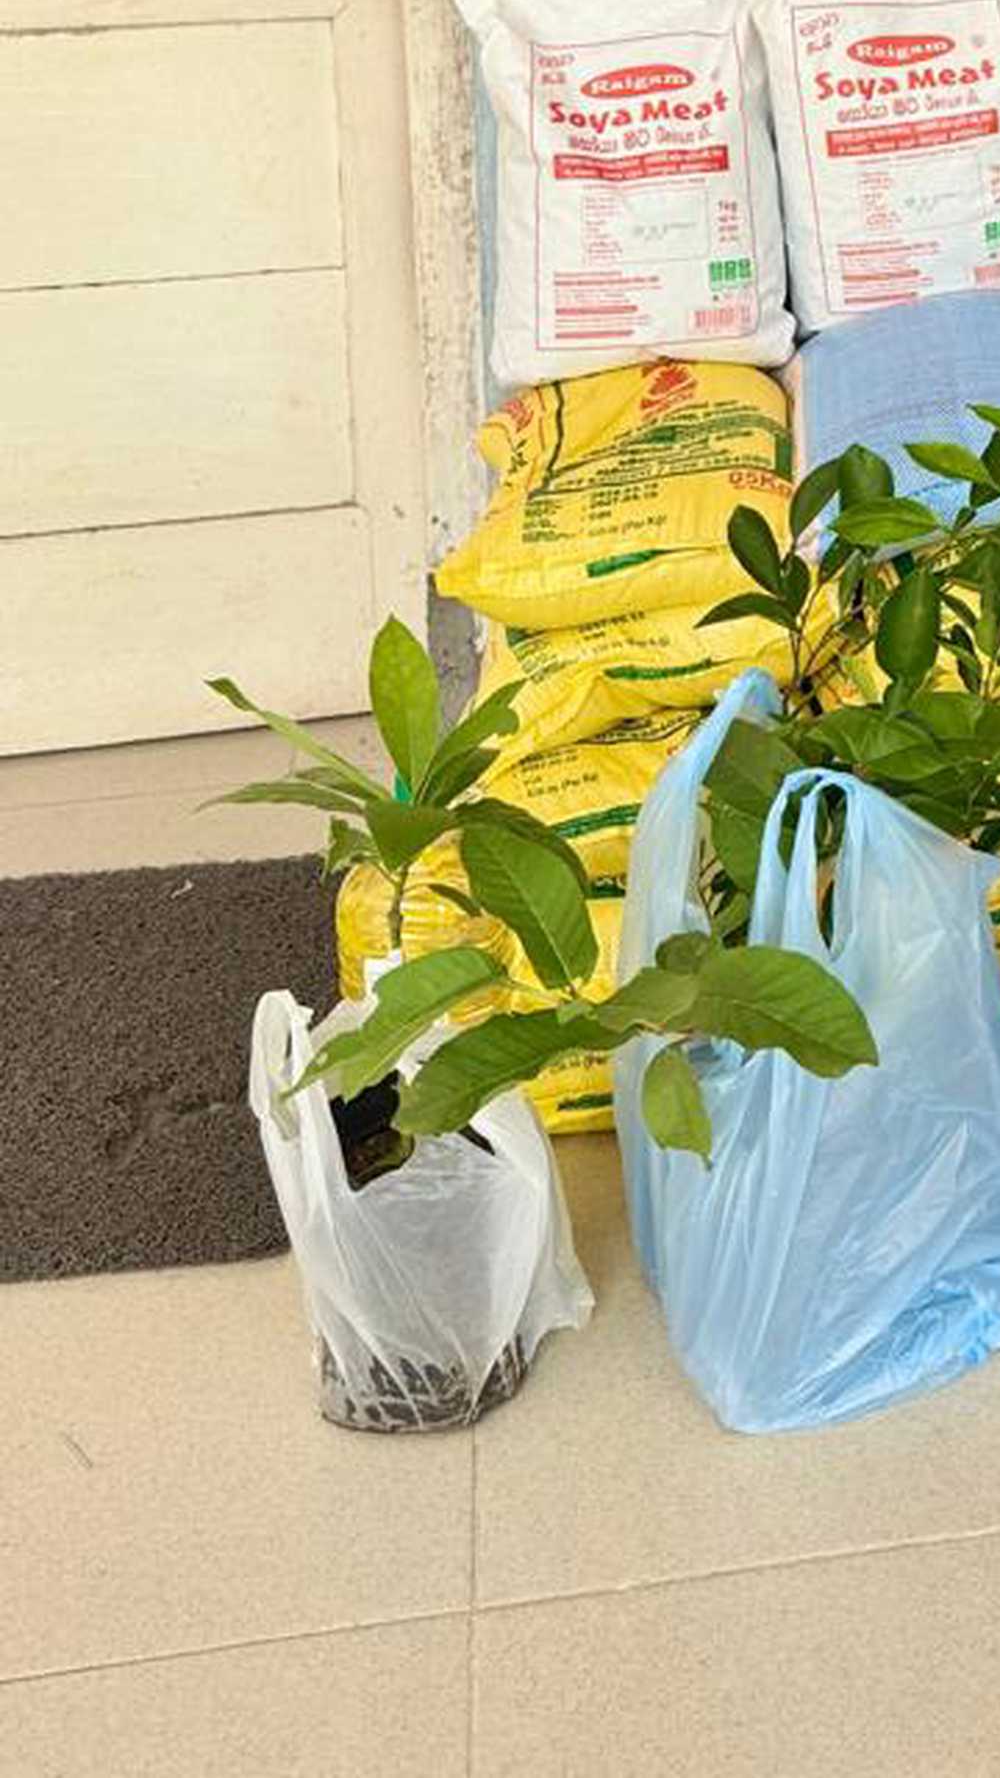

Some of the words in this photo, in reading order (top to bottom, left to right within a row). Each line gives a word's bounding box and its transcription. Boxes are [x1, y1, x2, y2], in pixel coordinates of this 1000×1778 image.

[856, 38, 948, 60] Raigam
[590, 73, 688, 95] Raigam
[814, 70, 899, 100] Soya
[907, 59, 995, 90] Meat
[548, 101, 633, 134] Soya
[642, 89, 729, 123] Meat
